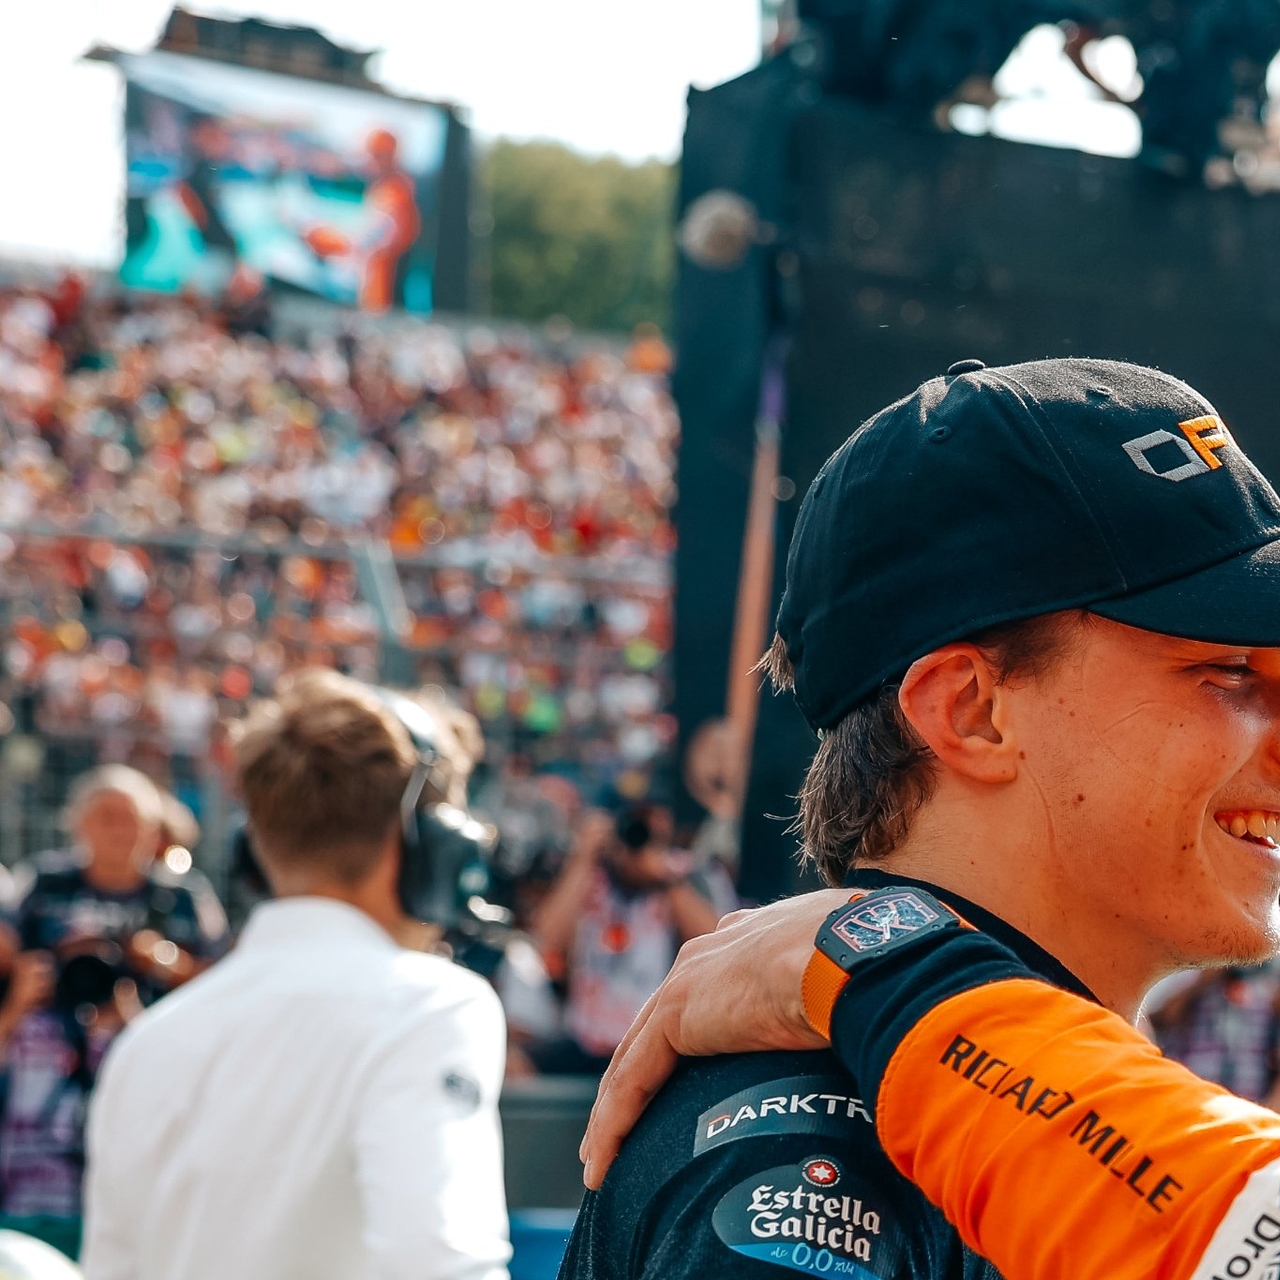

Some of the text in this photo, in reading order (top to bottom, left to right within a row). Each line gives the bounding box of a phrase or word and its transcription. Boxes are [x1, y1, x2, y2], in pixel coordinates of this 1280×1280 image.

[1069, 1109, 1185, 1214] MILE
[746, 1184, 881, 1235] Estrella
[750, 1211, 871, 1262] Galicia
